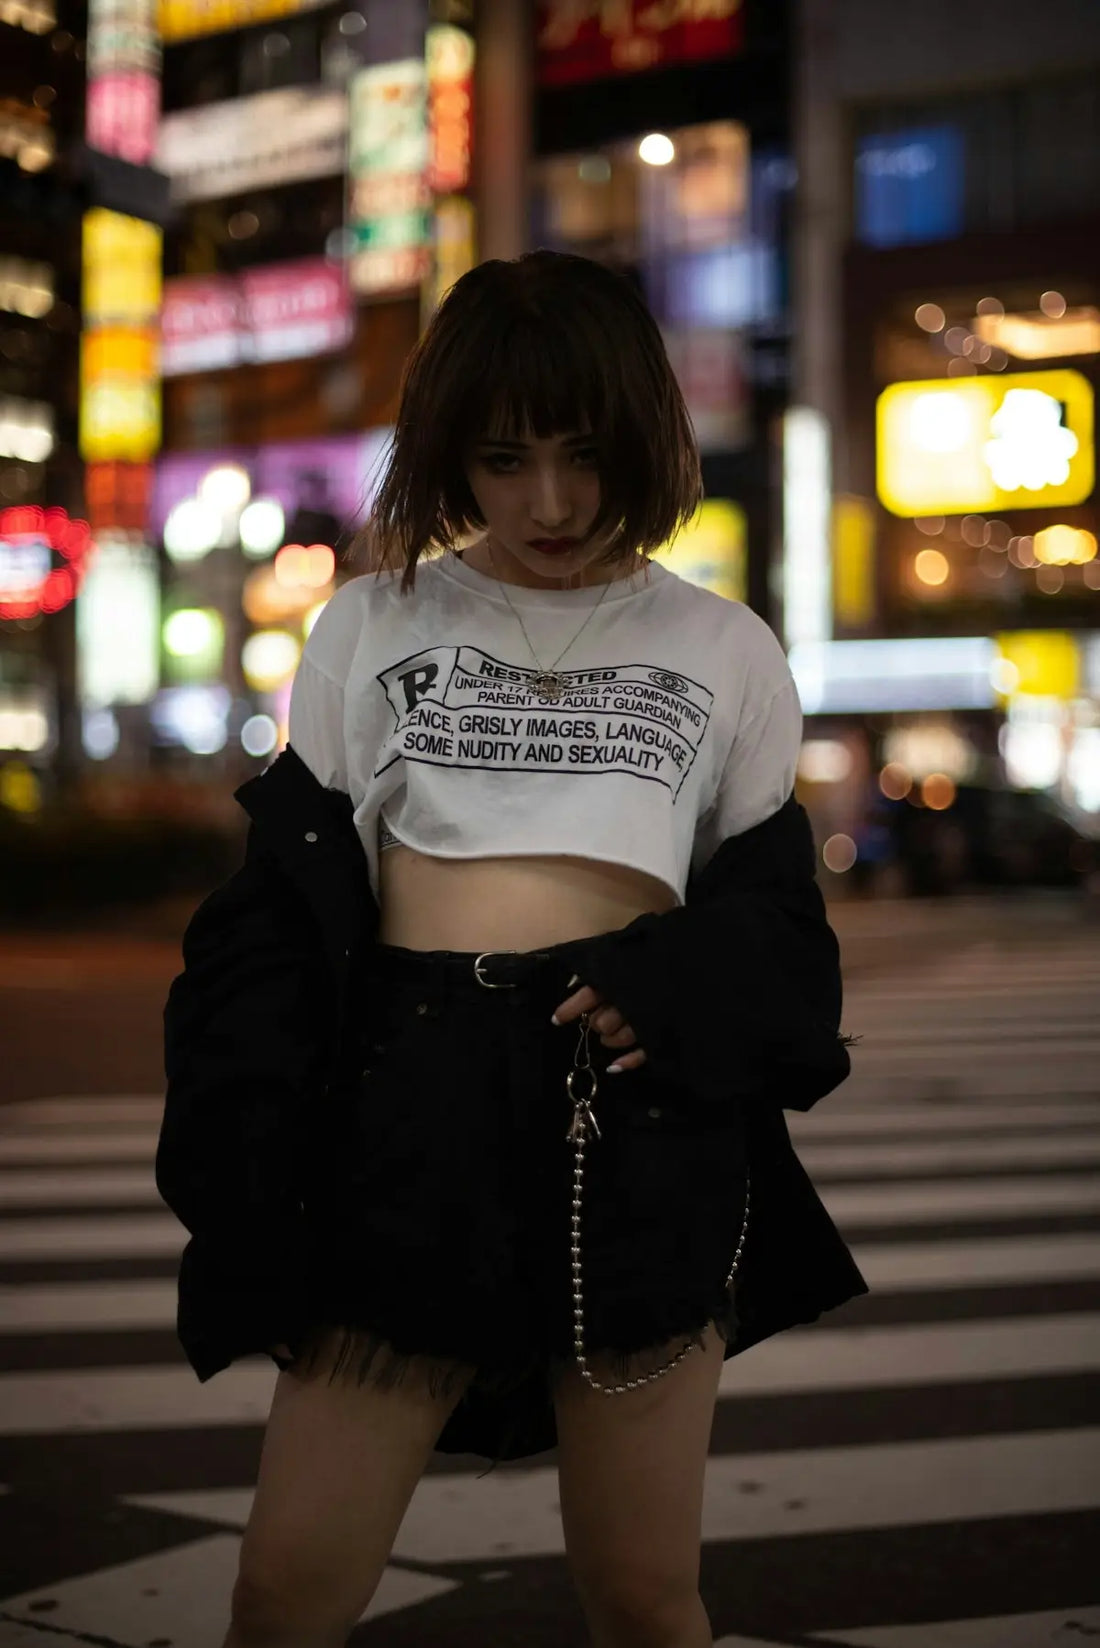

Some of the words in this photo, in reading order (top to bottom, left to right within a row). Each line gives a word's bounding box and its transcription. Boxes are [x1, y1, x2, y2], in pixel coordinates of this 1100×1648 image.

[398, 663, 439, 715] R
[480, 660, 617, 685] RESTCTED
[454, 675, 503, 690] UNDER
[602, 685, 701, 727] ACCOMPANYING
[477, 691, 536, 706] PARENT
[562, 696, 611, 709] ADULT
[613, 697, 682, 730] GUARDIAN
[403, 731, 454, 758] SOME
[457, 739, 522, 761] NUDITY
[524, 743, 564, 763] AND
[567, 744, 665, 772] SEXUALITY
[404, 708, 454, 737] ENCE,
[458, 714, 523, 737] GRISLY
[525, 718, 600, 743] IMAGES,
[606, 721, 687, 773] LANGUAGE,
